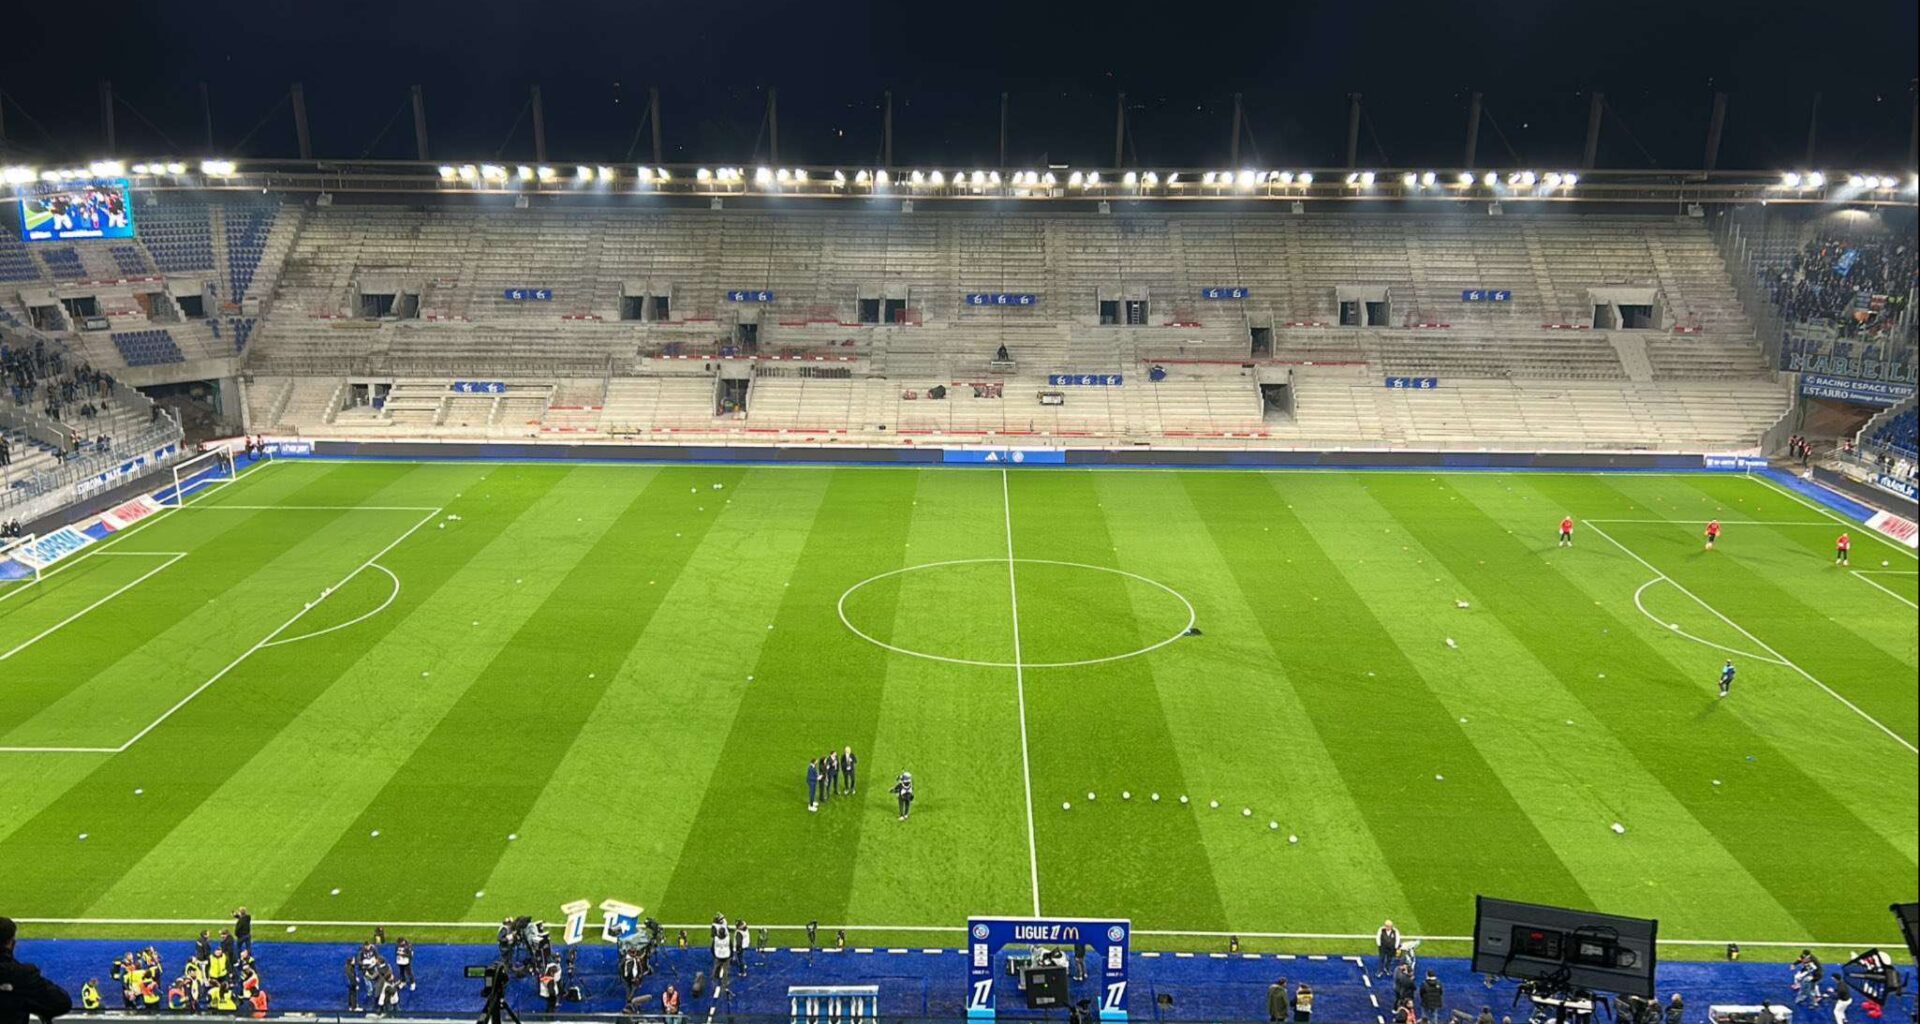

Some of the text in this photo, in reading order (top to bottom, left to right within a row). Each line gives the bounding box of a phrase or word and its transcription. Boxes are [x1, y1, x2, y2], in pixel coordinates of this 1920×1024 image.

[1802, 386, 1849, 399] EST-ARRO
[1816, 377, 1850, 389] RACING
[1851, 381, 1887, 393] ESPACE
[1015, 925, 1048, 940] LIGUE
